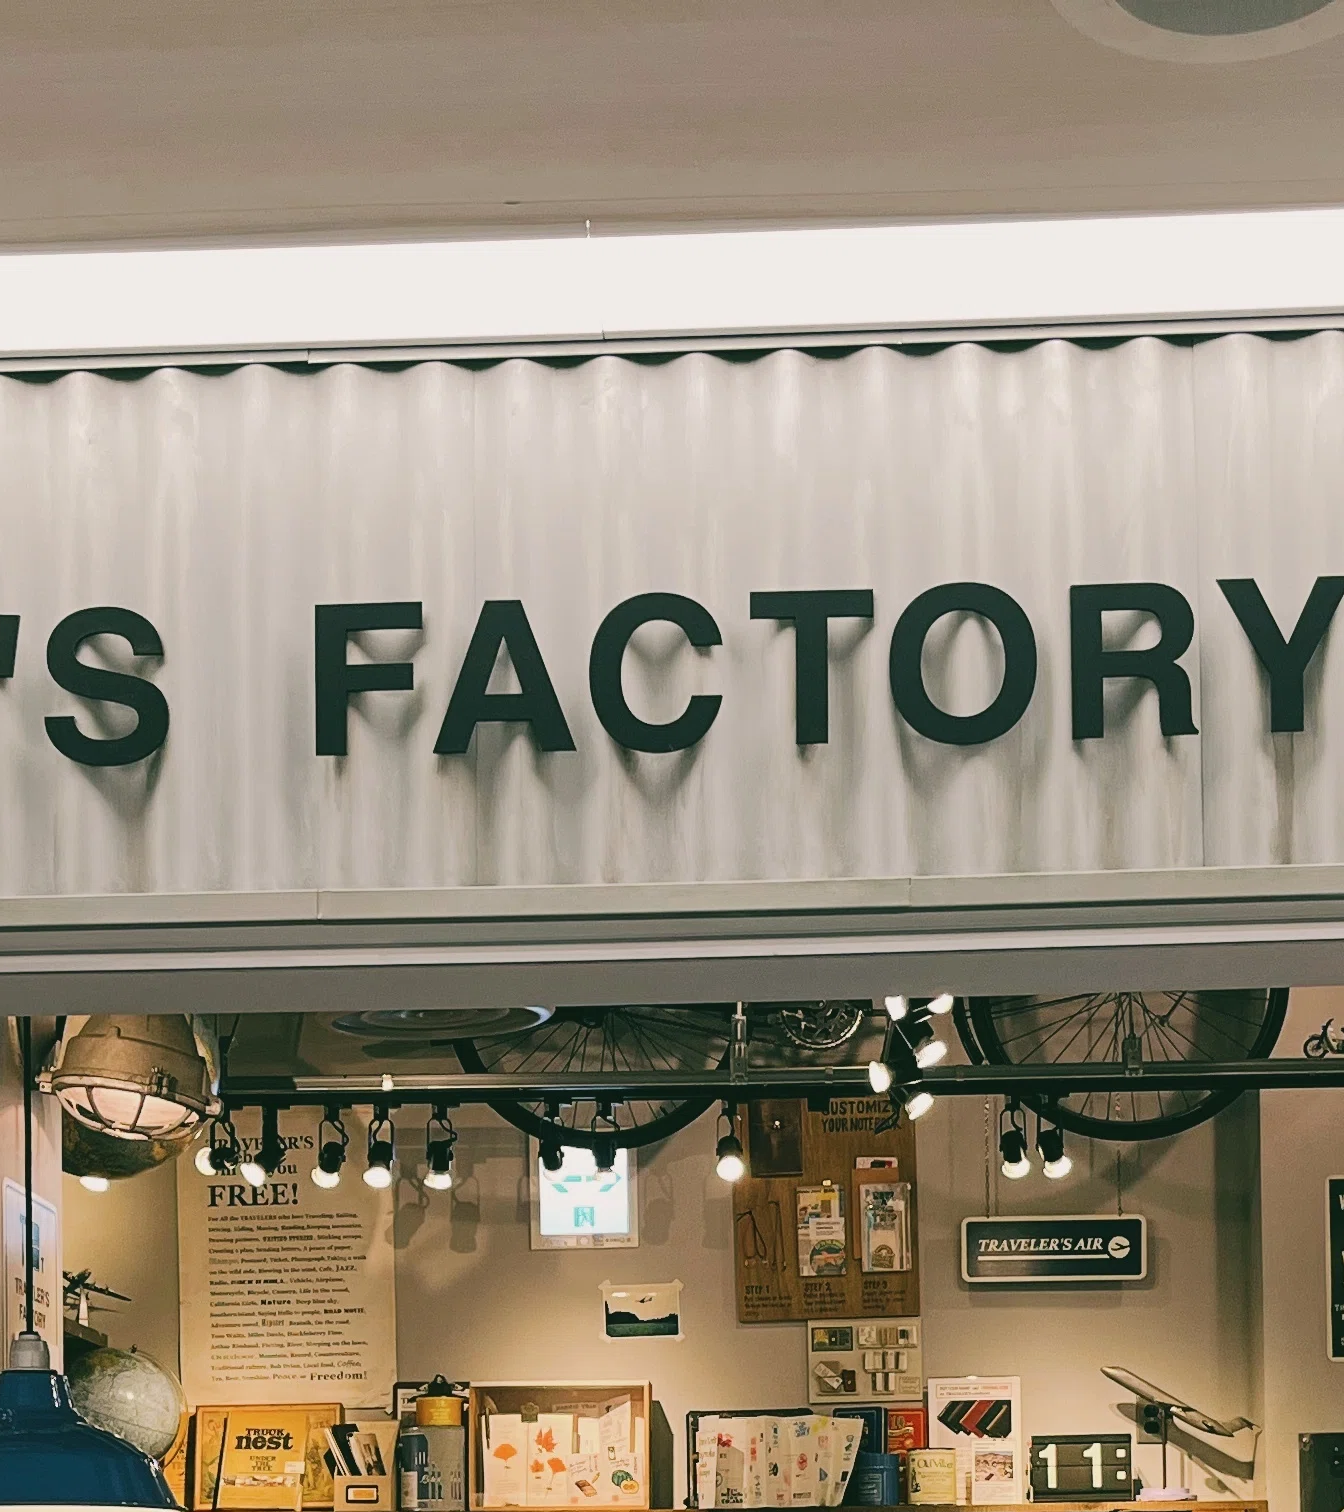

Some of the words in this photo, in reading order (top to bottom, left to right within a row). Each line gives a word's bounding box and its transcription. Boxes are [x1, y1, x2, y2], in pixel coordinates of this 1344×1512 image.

[822, 1118, 849, 1133] YOUR
[207, 1183, 299, 1207] FREE!
[977, 1236, 1073, 1253] TRAVELER'S
[1074, 1235, 1103, 1251] AIR
[826, 1283, 831, 1292] 2
[310, 1371, 368, 1381] Freedom!
[246, 1428, 285, 1436] TRUCK
[235, 1433, 293, 1450] nest
